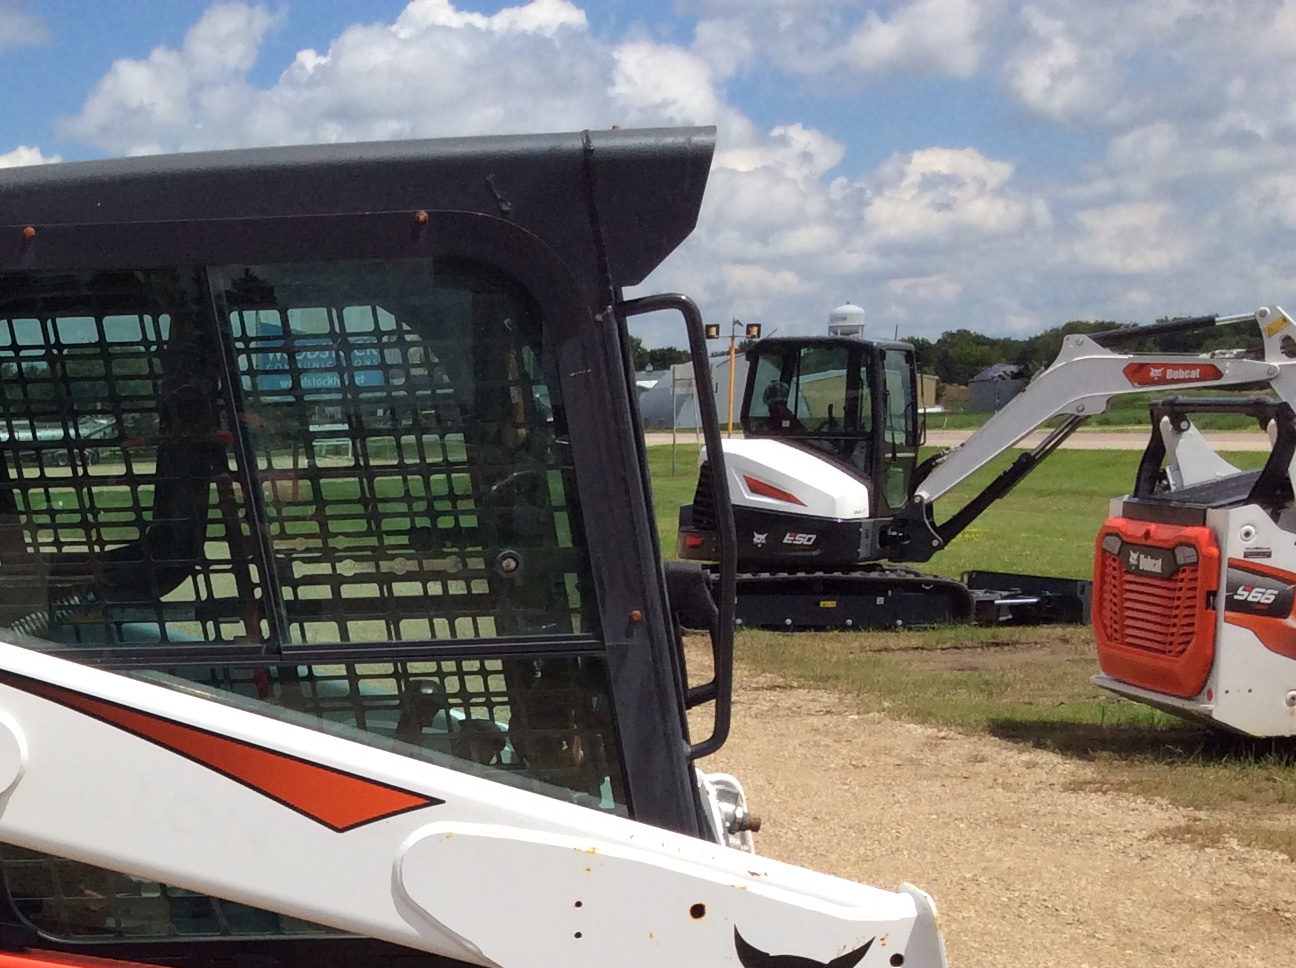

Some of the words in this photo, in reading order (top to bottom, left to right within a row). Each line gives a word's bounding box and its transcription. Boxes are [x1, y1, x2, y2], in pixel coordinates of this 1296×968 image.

[267, 340, 378, 361] WODSTCK
[1166, 368, 1200, 380] Bobcat
[782, 532, 817, 545] E50
[1233, 585, 1280, 604] S66
